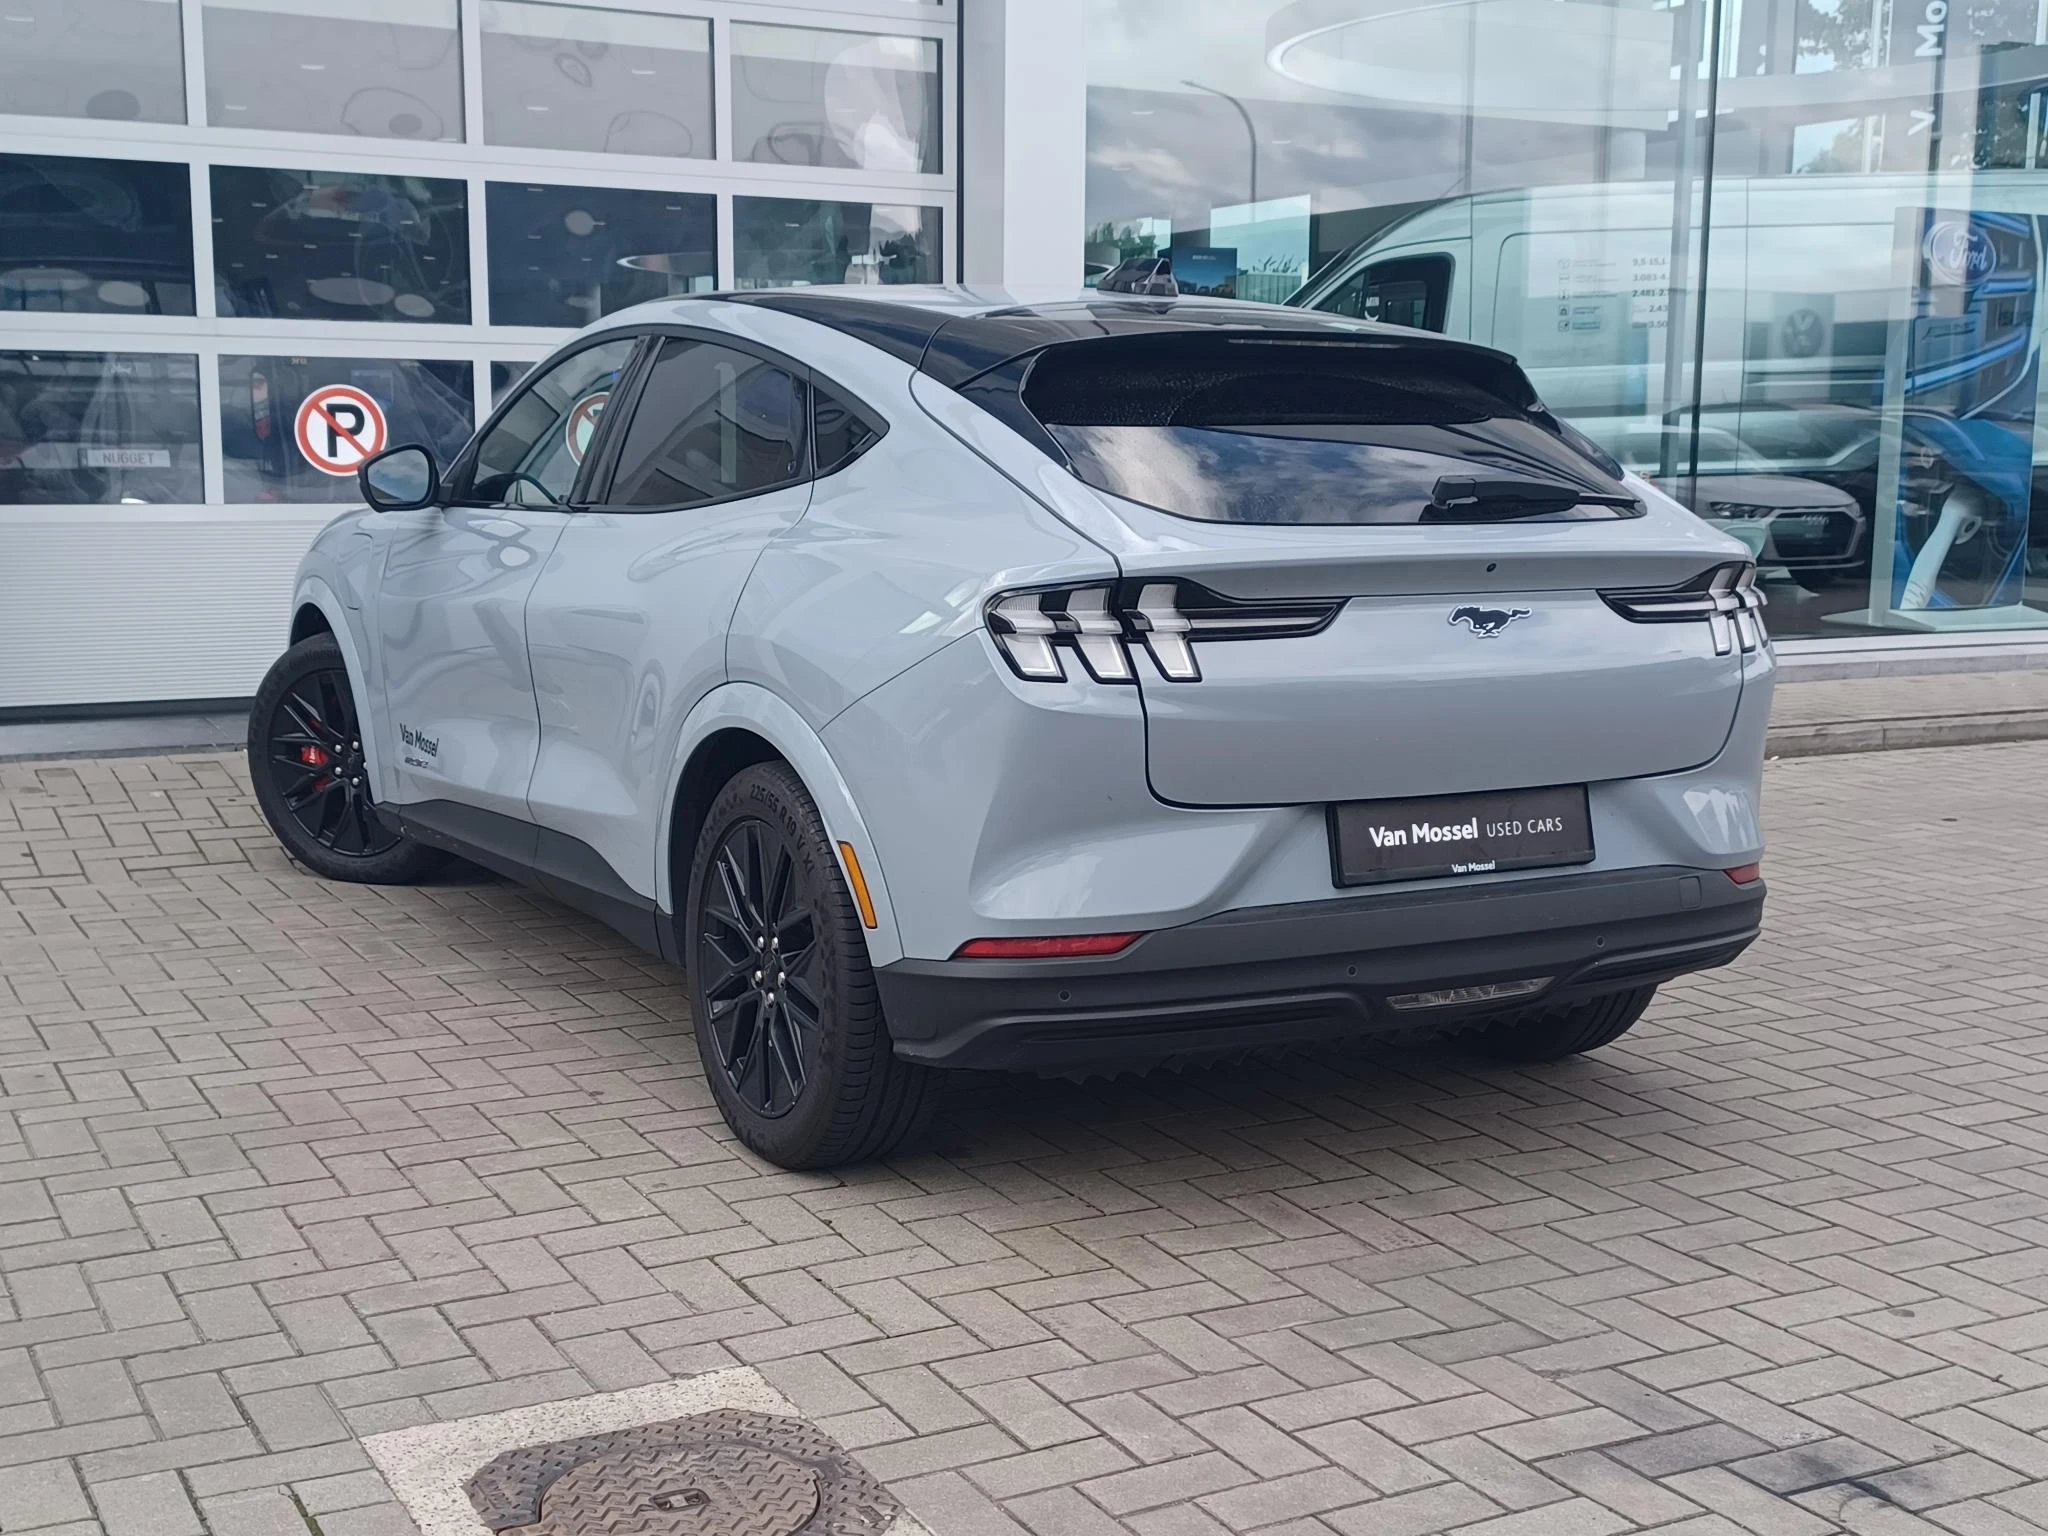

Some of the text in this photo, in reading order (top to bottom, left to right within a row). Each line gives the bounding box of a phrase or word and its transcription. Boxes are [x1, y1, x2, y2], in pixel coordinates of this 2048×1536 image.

[326, 403, 365, 458] P
[103, 451, 155, 465] NUGGET
[399, 722, 439, 757] Van Mossel
[1369, 817, 1563, 848] Van Mossel USED CARS
[1451, 860, 1496, 873] Van Mossel
